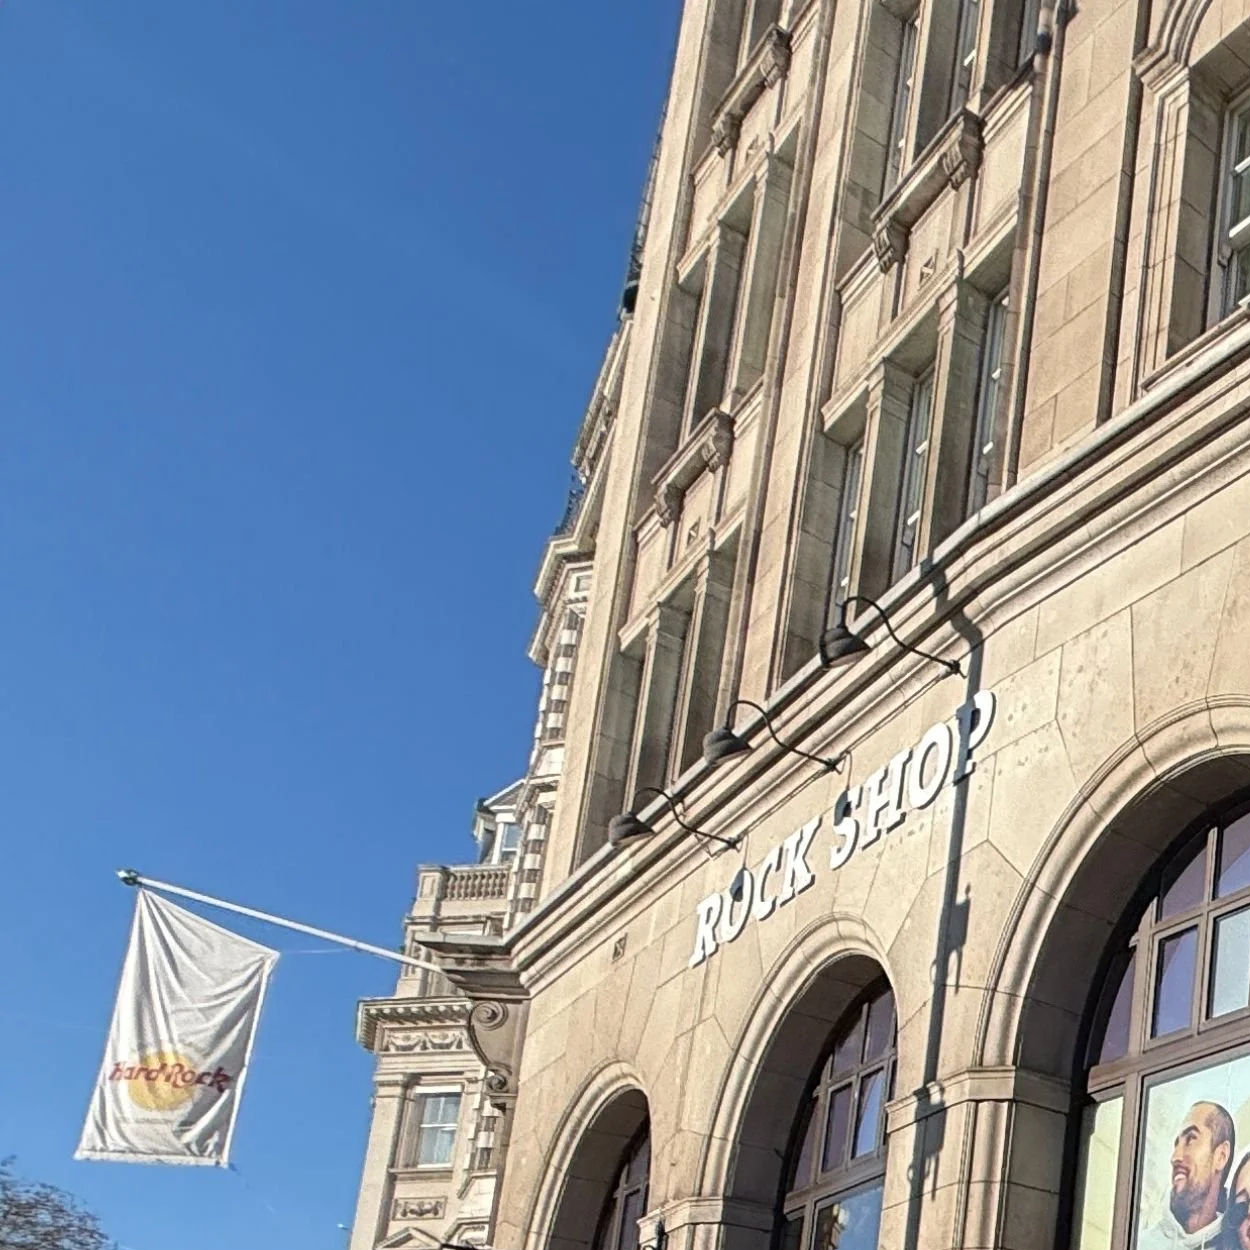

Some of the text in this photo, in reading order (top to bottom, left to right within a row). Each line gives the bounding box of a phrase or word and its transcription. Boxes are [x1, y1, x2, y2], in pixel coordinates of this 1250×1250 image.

[688, 689, 996, 968] ROCK SHOP
[109, 1061, 231, 1093] Hard Rock
